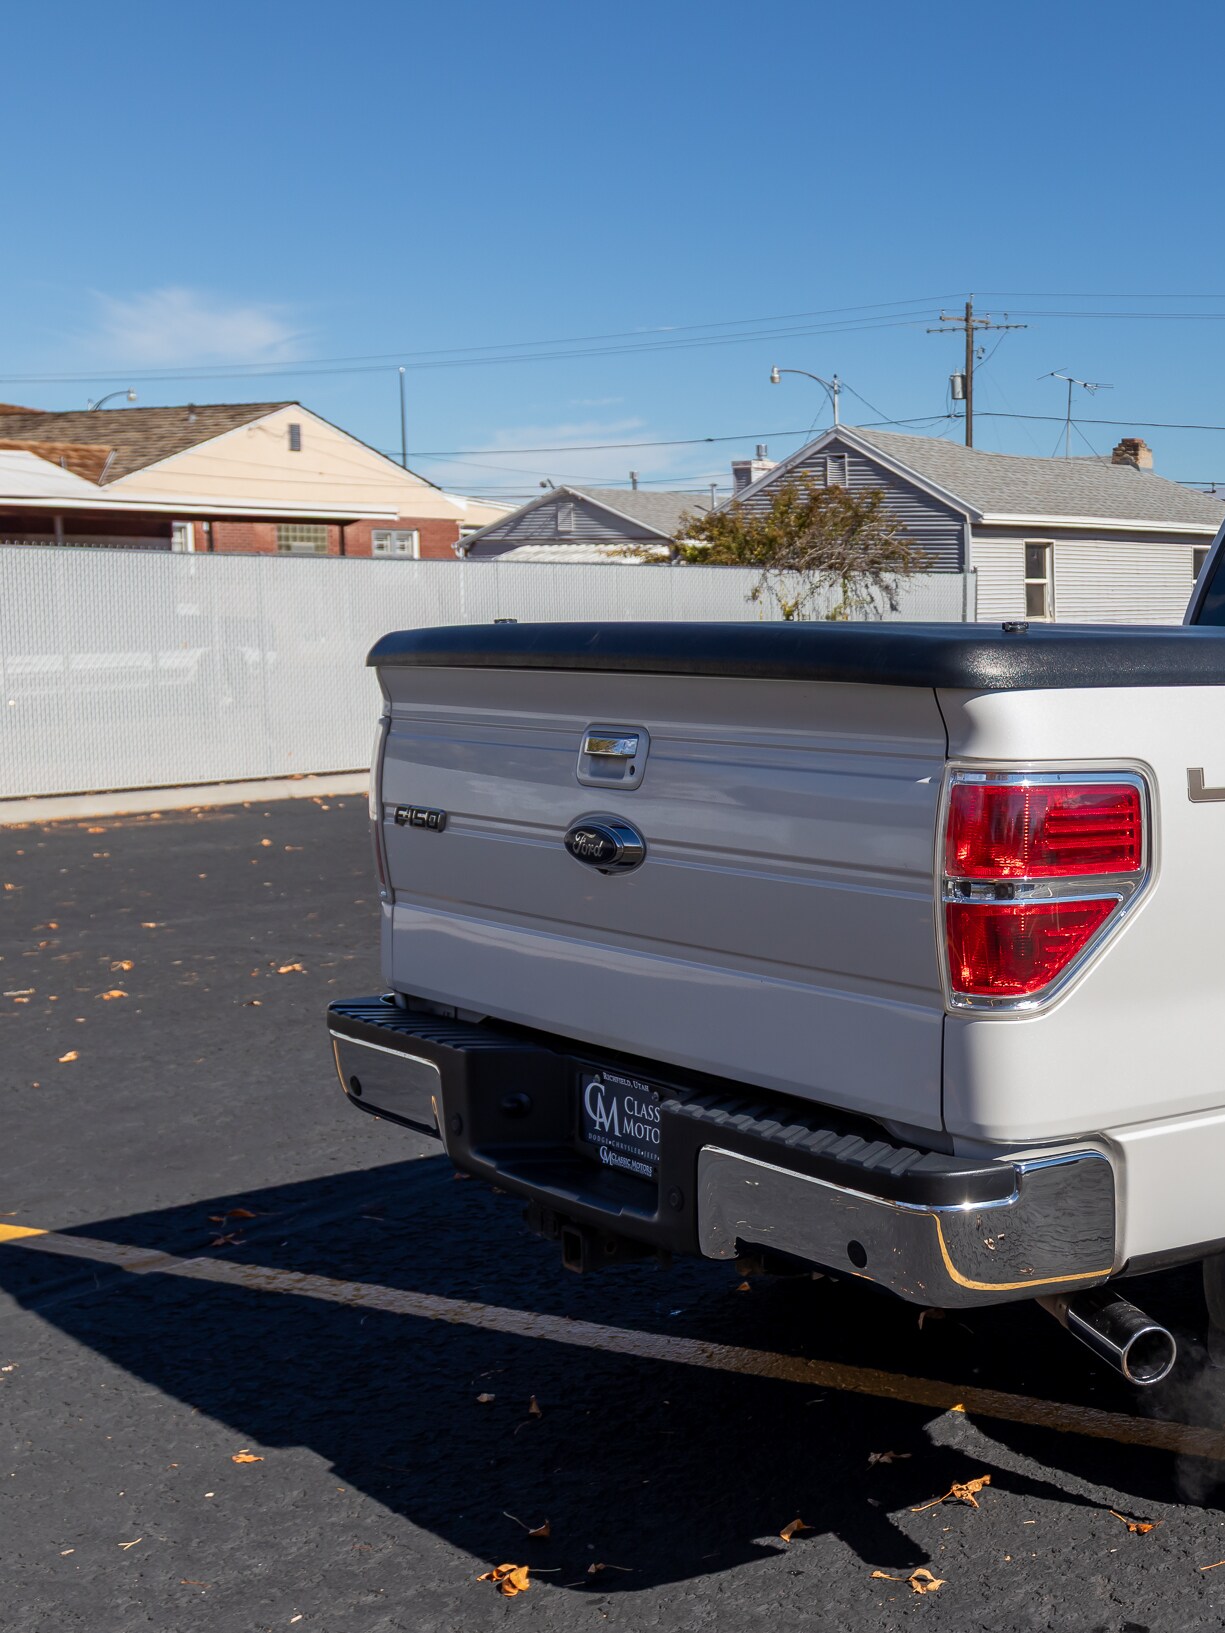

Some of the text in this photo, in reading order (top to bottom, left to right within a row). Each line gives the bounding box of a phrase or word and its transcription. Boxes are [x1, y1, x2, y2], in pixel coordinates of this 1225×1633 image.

[573, 831, 604, 857] Ford
[624, 1096, 660, 1122] CLASS
[622, 1117, 660, 1143] MOTO
